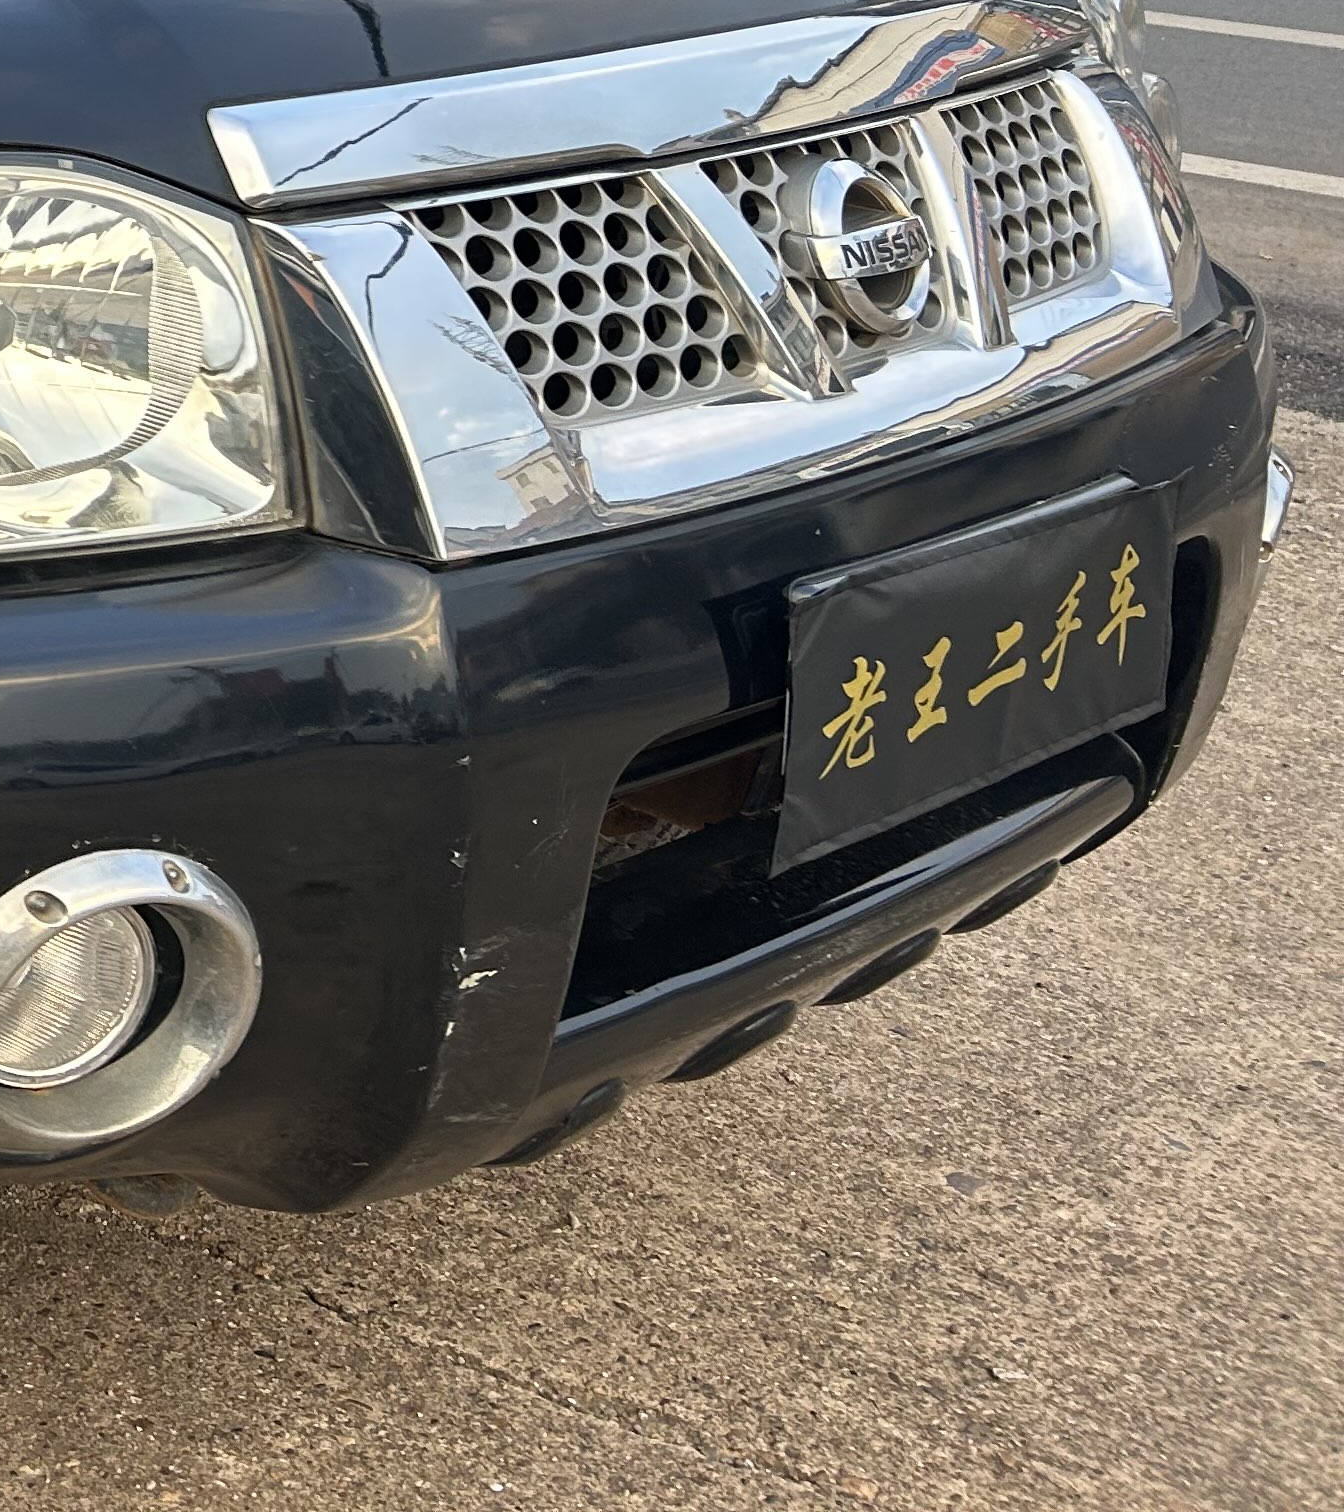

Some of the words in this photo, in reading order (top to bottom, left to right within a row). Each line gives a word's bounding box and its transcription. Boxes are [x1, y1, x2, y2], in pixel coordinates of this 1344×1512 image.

[819, 543, 1146, 780] 老王二手车
